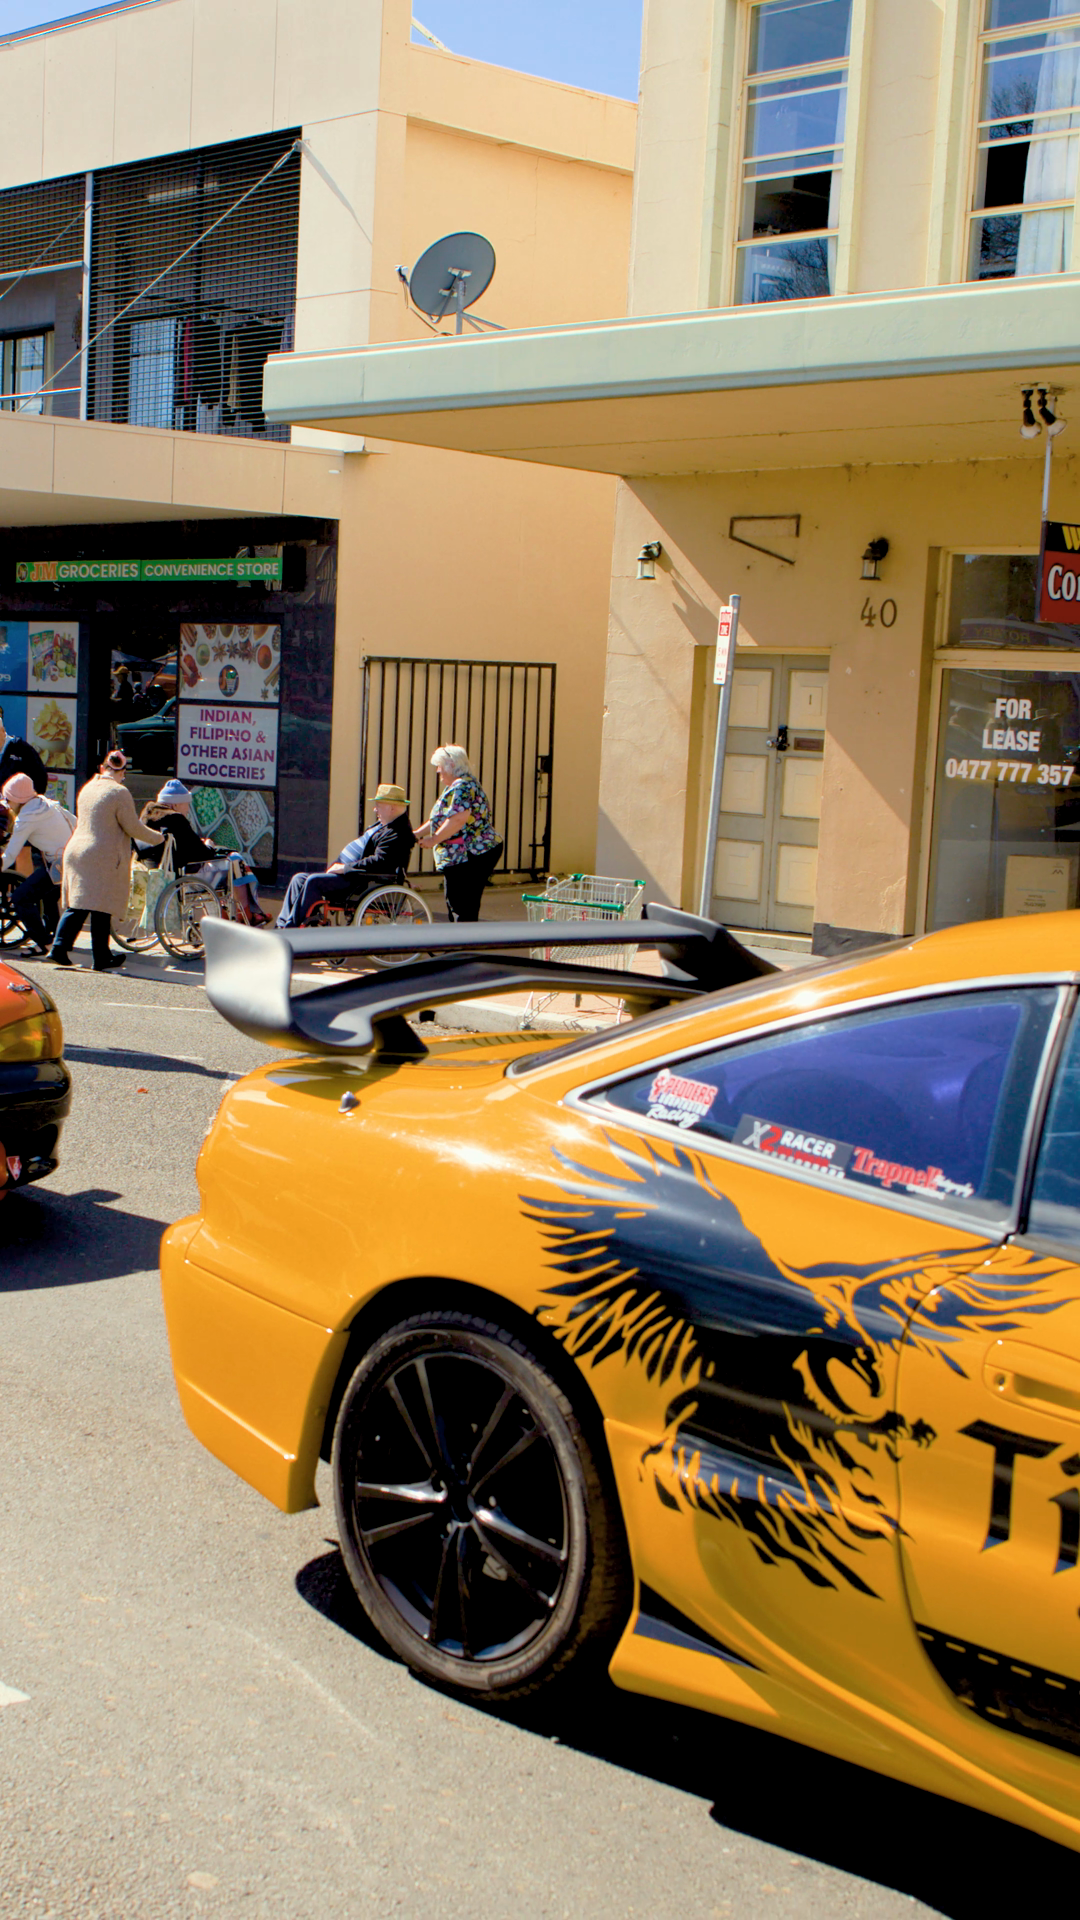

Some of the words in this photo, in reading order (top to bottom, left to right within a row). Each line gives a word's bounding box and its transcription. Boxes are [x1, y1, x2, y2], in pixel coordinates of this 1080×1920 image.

[30, 561, 59, 581] JM
[59, 563, 139, 578] GROCERIES
[144, 564, 234, 577] CONVENIENCE
[237, 563, 279, 576] STORE
[1047, 564, 1080, 601] Co
[861, 597, 897, 628] 40
[200, 709, 256, 726] INDIAN,
[994, 697, 1032, 720] FOR
[190, 726, 252, 743] FILIPINO
[255, 730, 266, 744] &
[982, 729, 1041, 752] LEASE
[180, 743, 228, 760] OTHER
[231, 747, 275, 763] ASIAN
[188, 762, 266, 781] GROCERIES
[945, 758, 992, 781] 0477
[997, 761, 1032, 783] 777
[1037, 764, 1075, 786] 357
[664, 1076, 717, 1106] PEDDERS
[646, 1103, 700, 1129] Racing
[780, 1130, 836, 1160] RACER
